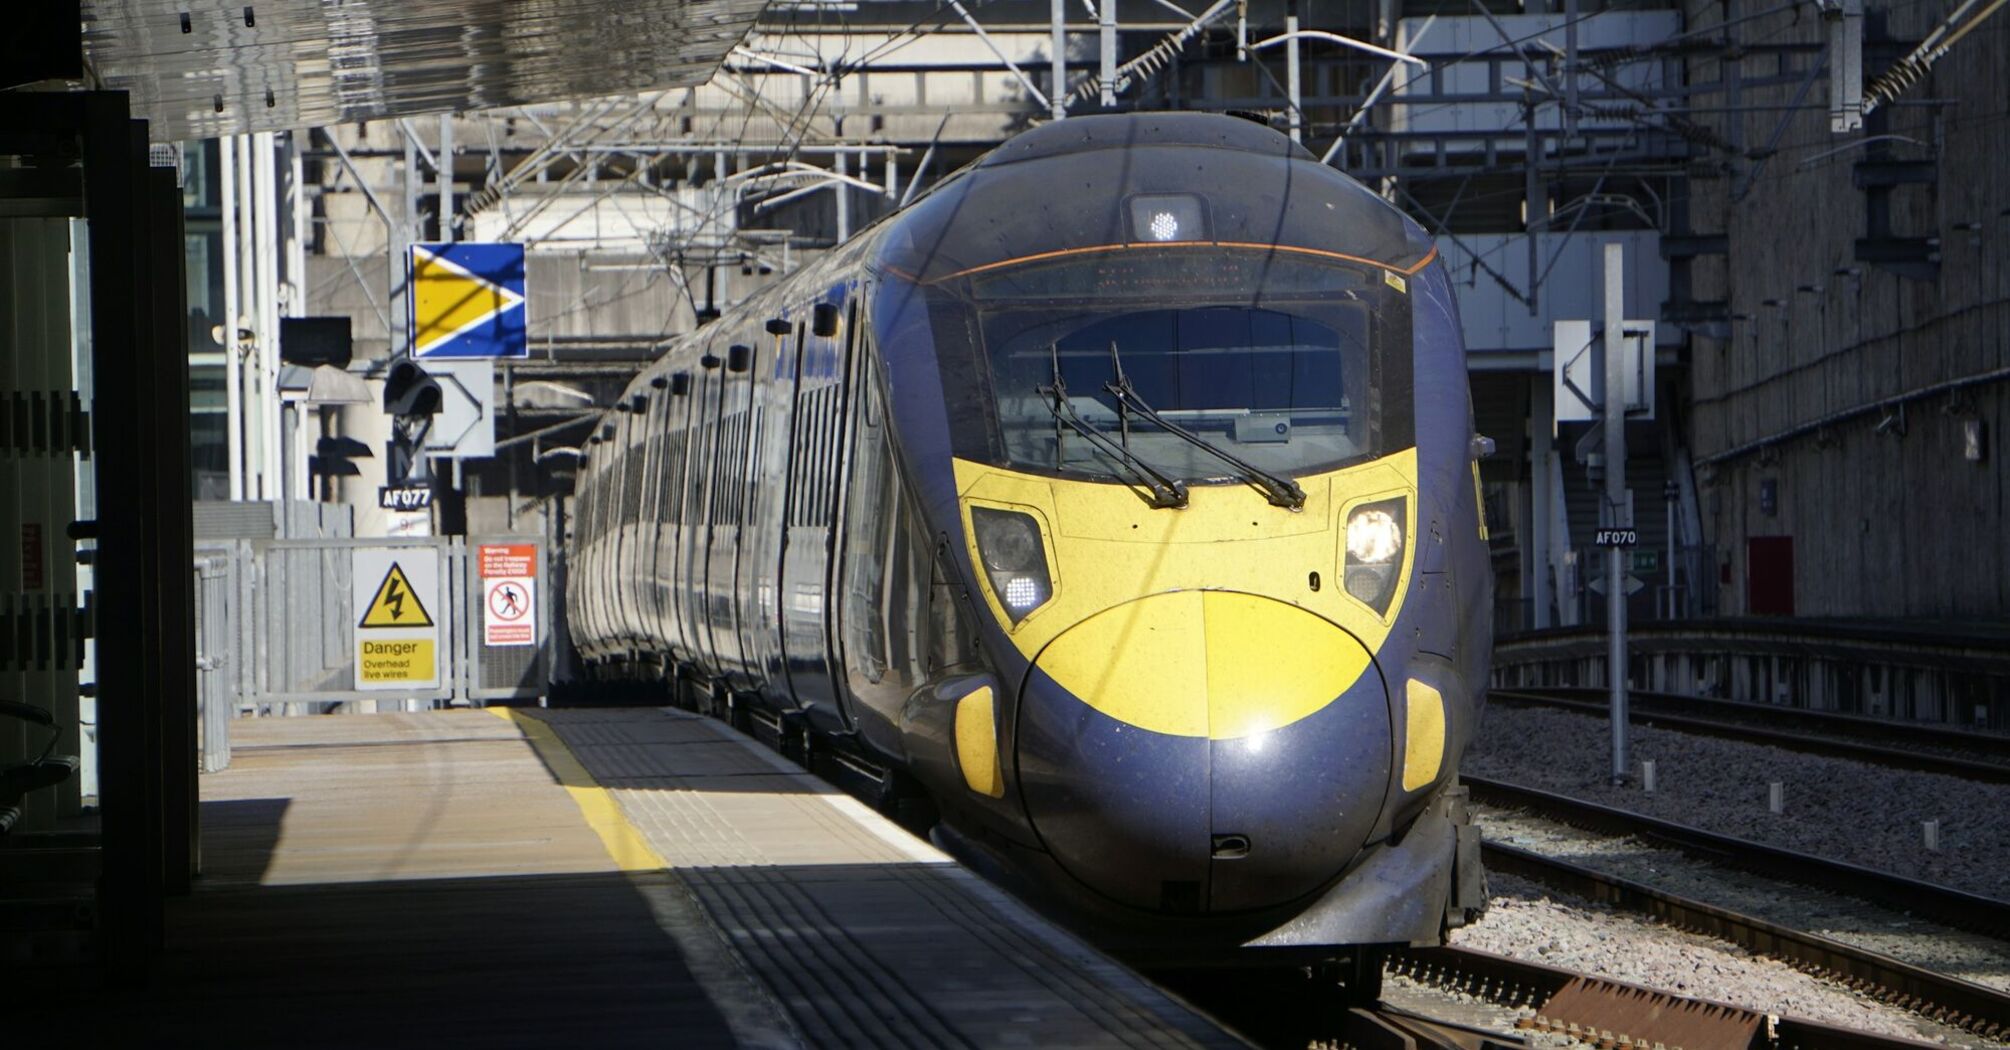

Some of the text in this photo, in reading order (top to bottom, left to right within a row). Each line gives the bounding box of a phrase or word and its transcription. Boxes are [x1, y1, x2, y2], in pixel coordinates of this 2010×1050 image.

[383, 489, 431, 506] AF077
[1596, 531, 1636, 544] AF070
[364, 641, 418, 656] Danger
[364, 659, 410, 669] Overhead
[364, 670, 409, 679] live wires
